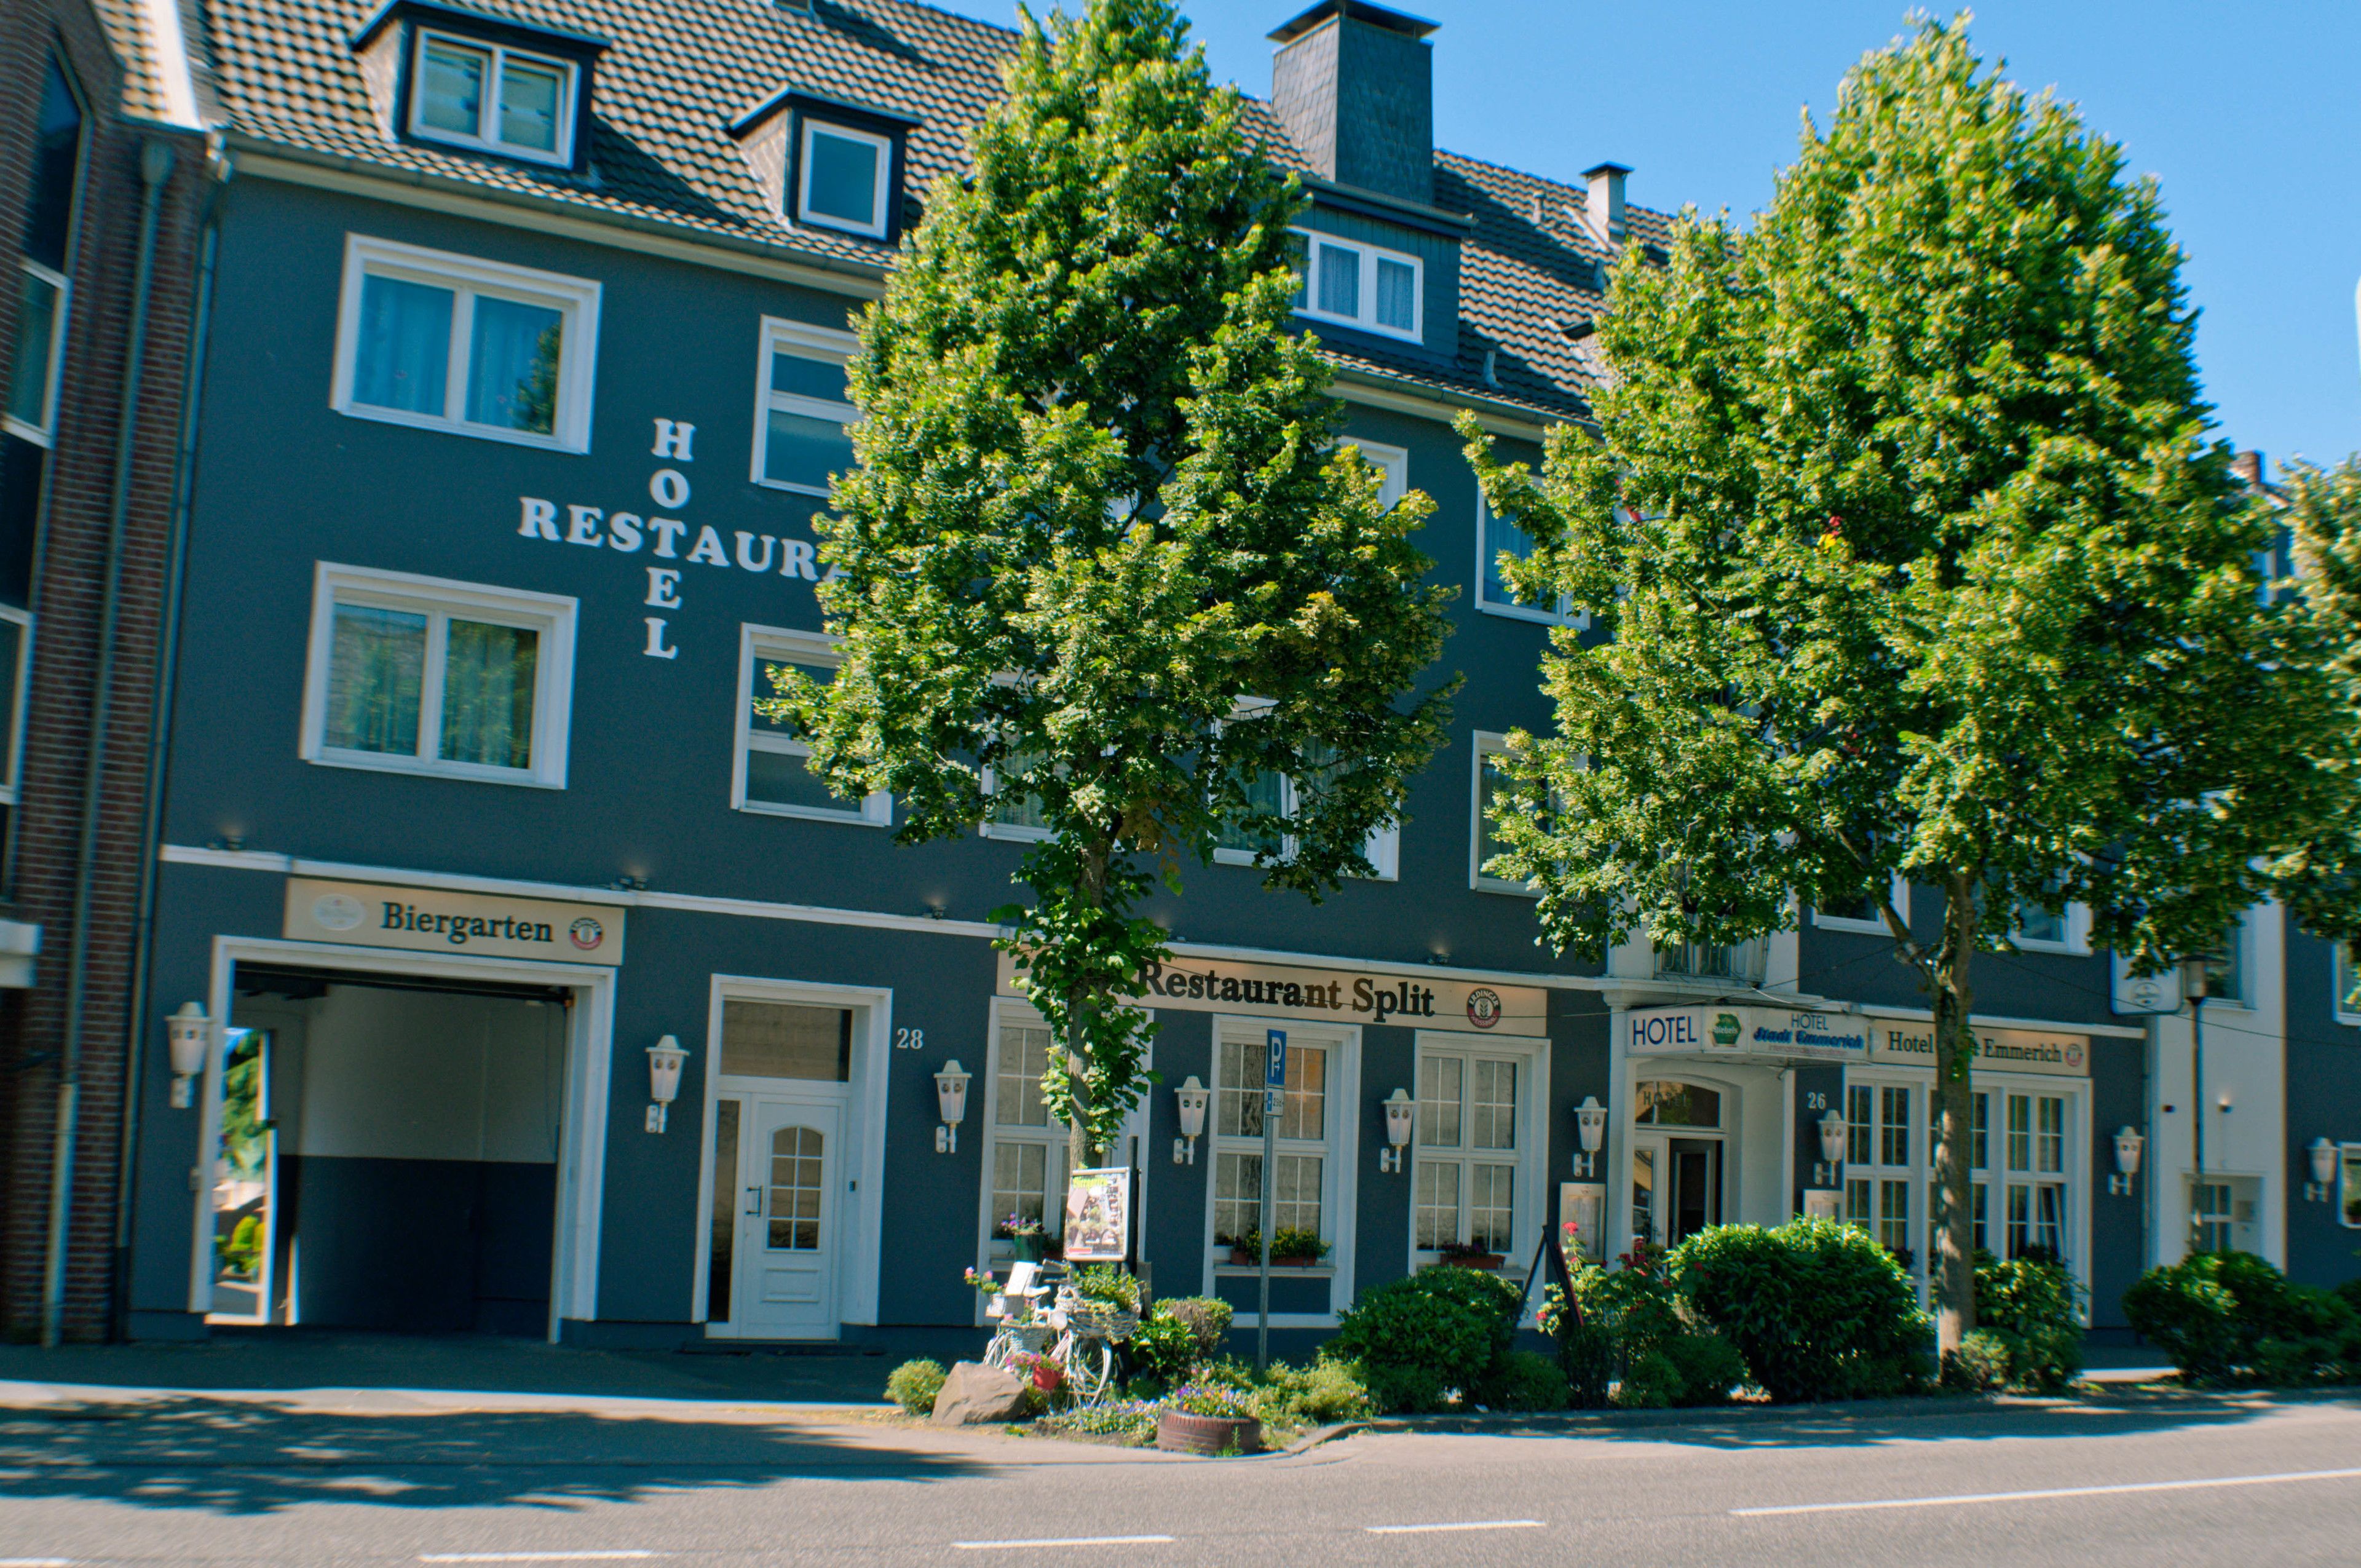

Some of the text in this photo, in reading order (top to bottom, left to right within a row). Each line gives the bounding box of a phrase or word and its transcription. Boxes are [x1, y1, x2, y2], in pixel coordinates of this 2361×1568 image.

[644, 418, 696, 659] HOTEL
[381, 901, 553, 944] Biergarten
[1137, 959, 1435, 1023] Restaurant Split
[1468, 989, 1499, 1007] ERDINGER
[1633, 1016, 1698, 1045] HOTEL
[1791, 1013, 1829, 1030] HOTEL
[896, 1028, 923, 1049] 28
[1754, 1026, 1793, 1043] Stadt
[1796, 1030, 1864, 1050] Emmerich
[1888, 1031, 2063, 1063] Hotel Emmerich
[1271, 1037, 1282, 1077] P
[1807, 1091, 1826, 1109] 26
